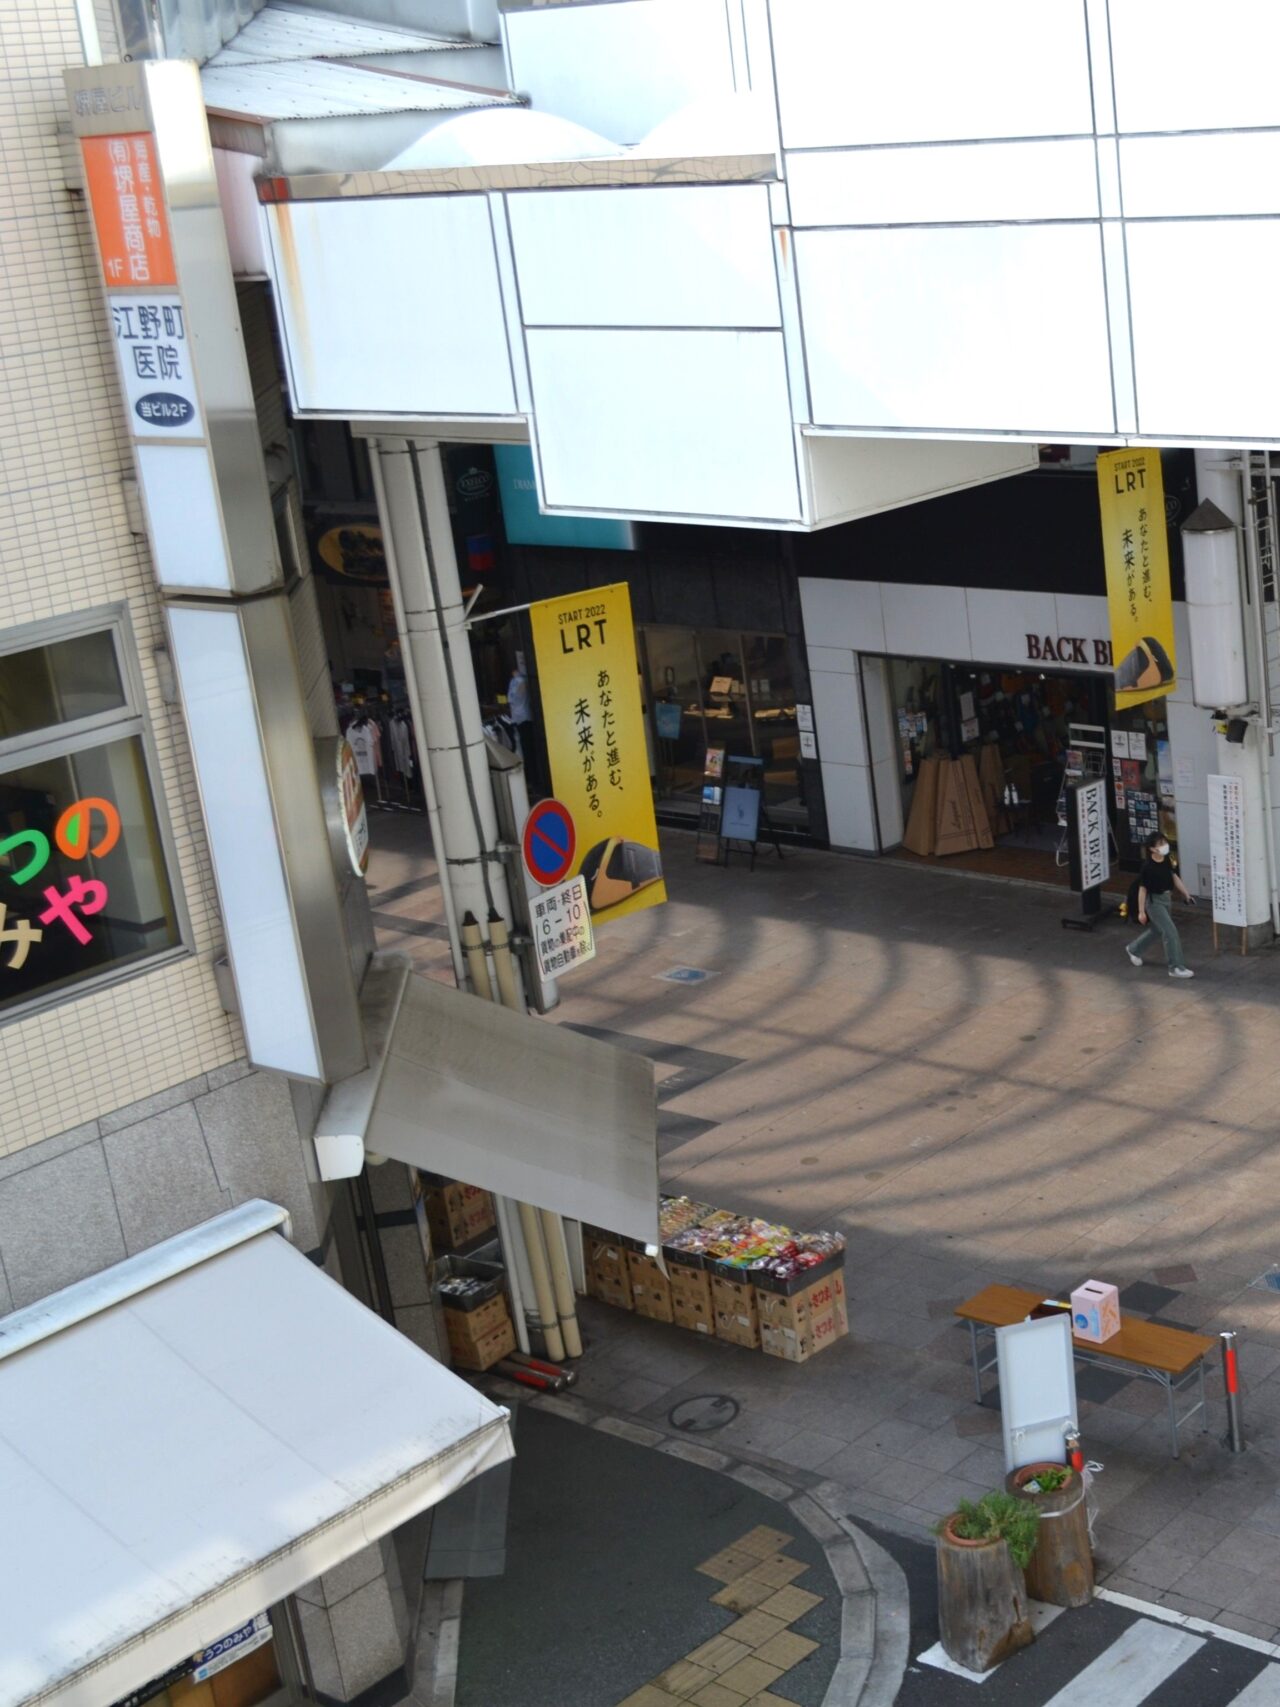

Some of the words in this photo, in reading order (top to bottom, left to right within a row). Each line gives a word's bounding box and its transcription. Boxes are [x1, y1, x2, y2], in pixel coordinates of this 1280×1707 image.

[112, 305, 184, 340] 江野町
[132, 345, 182, 380] 医院
[140, 401, 188, 418] 当ビル2F
[1115, 468, 1146, 495] LRT
[1122, 528, 1140, 622] 未来がある。
[558, 611, 582, 625] START
[584, 604, 606, 619] 2022
[560, 619, 607, 654] LRT
[1025, 633, 1089, 664] BACK
[597, 669, 624, 792] あなたと進む、
[573, 698, 603, 818] 未来がある。
[1086, 787, 1099, 834] BACK
[1089, 838, 1102, 880] BEAT
[204, 1624, 253, 1661] うつのみや
